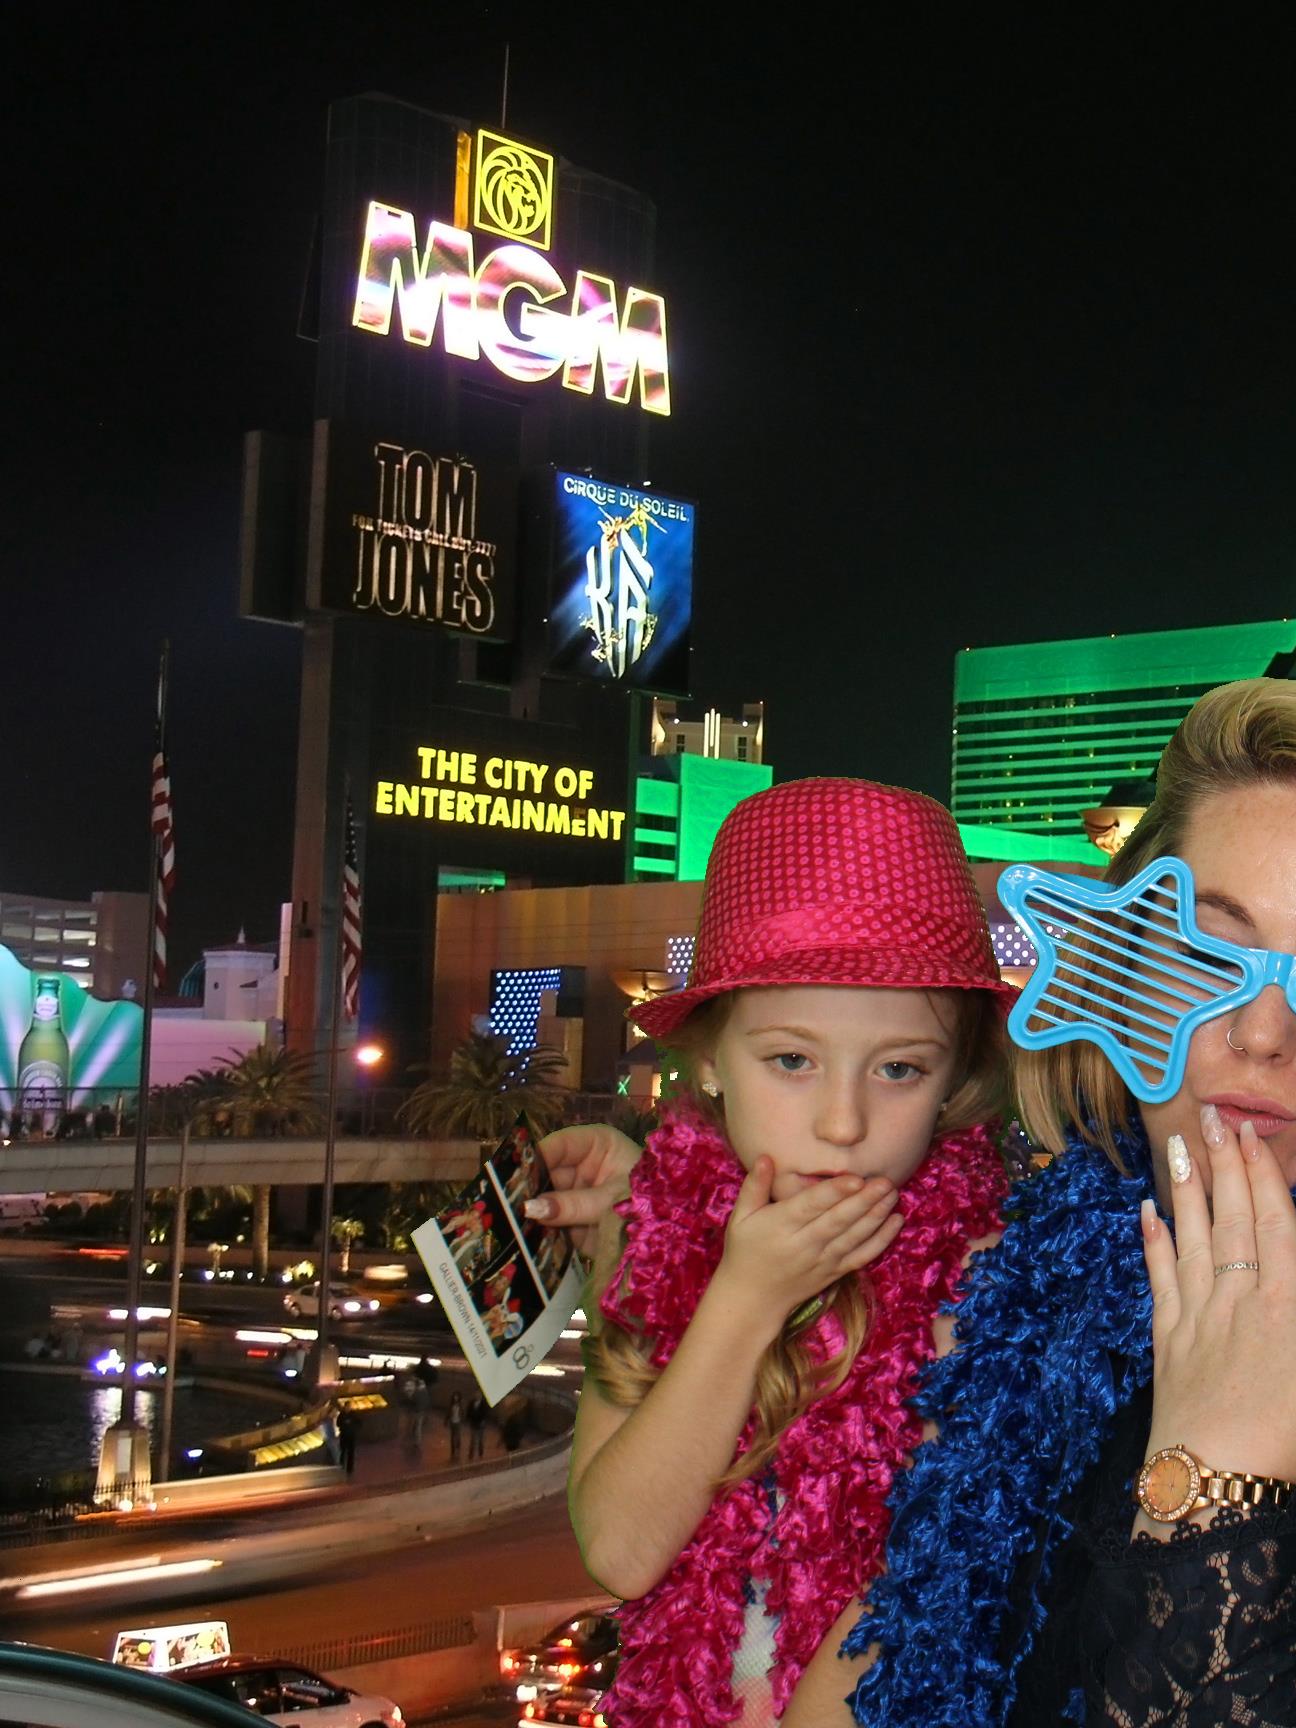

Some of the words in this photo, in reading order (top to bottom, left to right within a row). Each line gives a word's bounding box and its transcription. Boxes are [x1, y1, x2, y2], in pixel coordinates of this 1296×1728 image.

[353, 201, 672, 416] MGM
[375, 442, 477, 540] TOM
[563, 477, 616, 506] CIRQUE
[619, 491, 639, 510] DU
[353, 531, 496, 633] JONES
[417, 747, 478, 784] THE
[484, 757, 549, 794] CITY
[554, 767, 594, 800] OF
